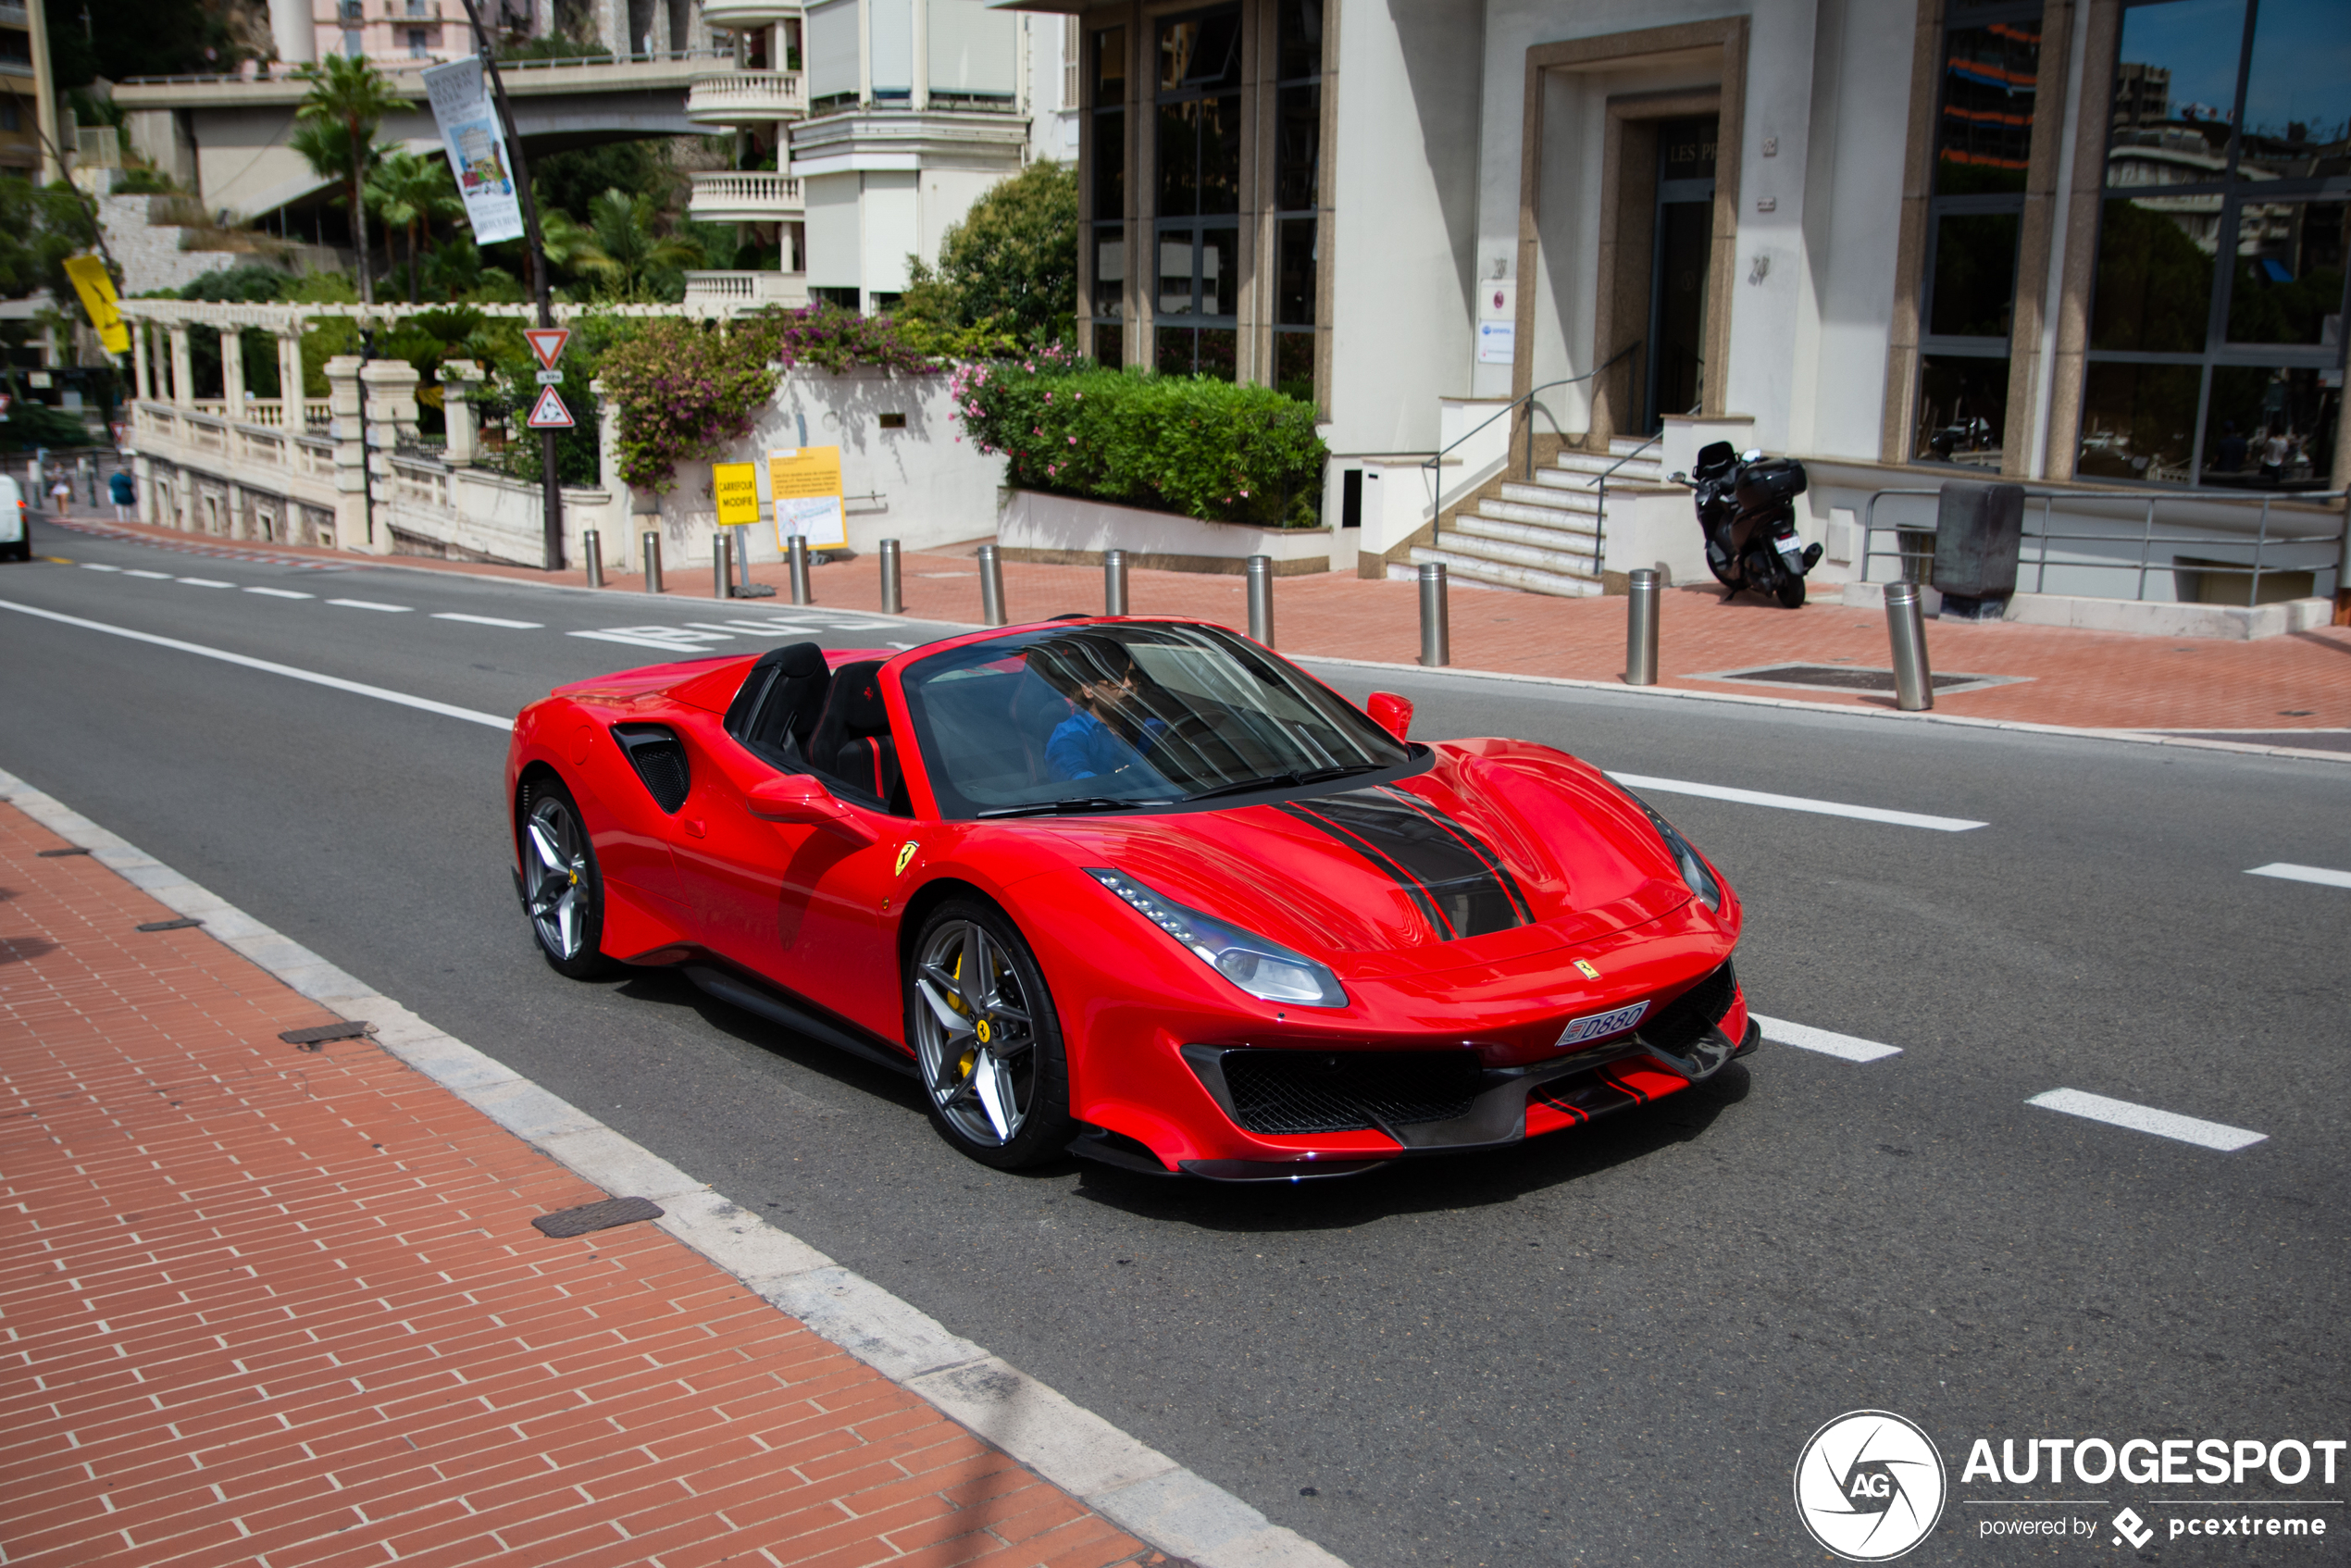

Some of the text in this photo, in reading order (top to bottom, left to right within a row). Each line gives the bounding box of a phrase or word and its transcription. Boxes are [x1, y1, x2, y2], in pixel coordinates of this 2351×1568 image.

[1670, 143, 1696, 162] LES
[719, 480, 753, 492] CARREFOUR
[565, 615, 908, 653] BUS
[1581, 1007, 1642, 1039] D880
